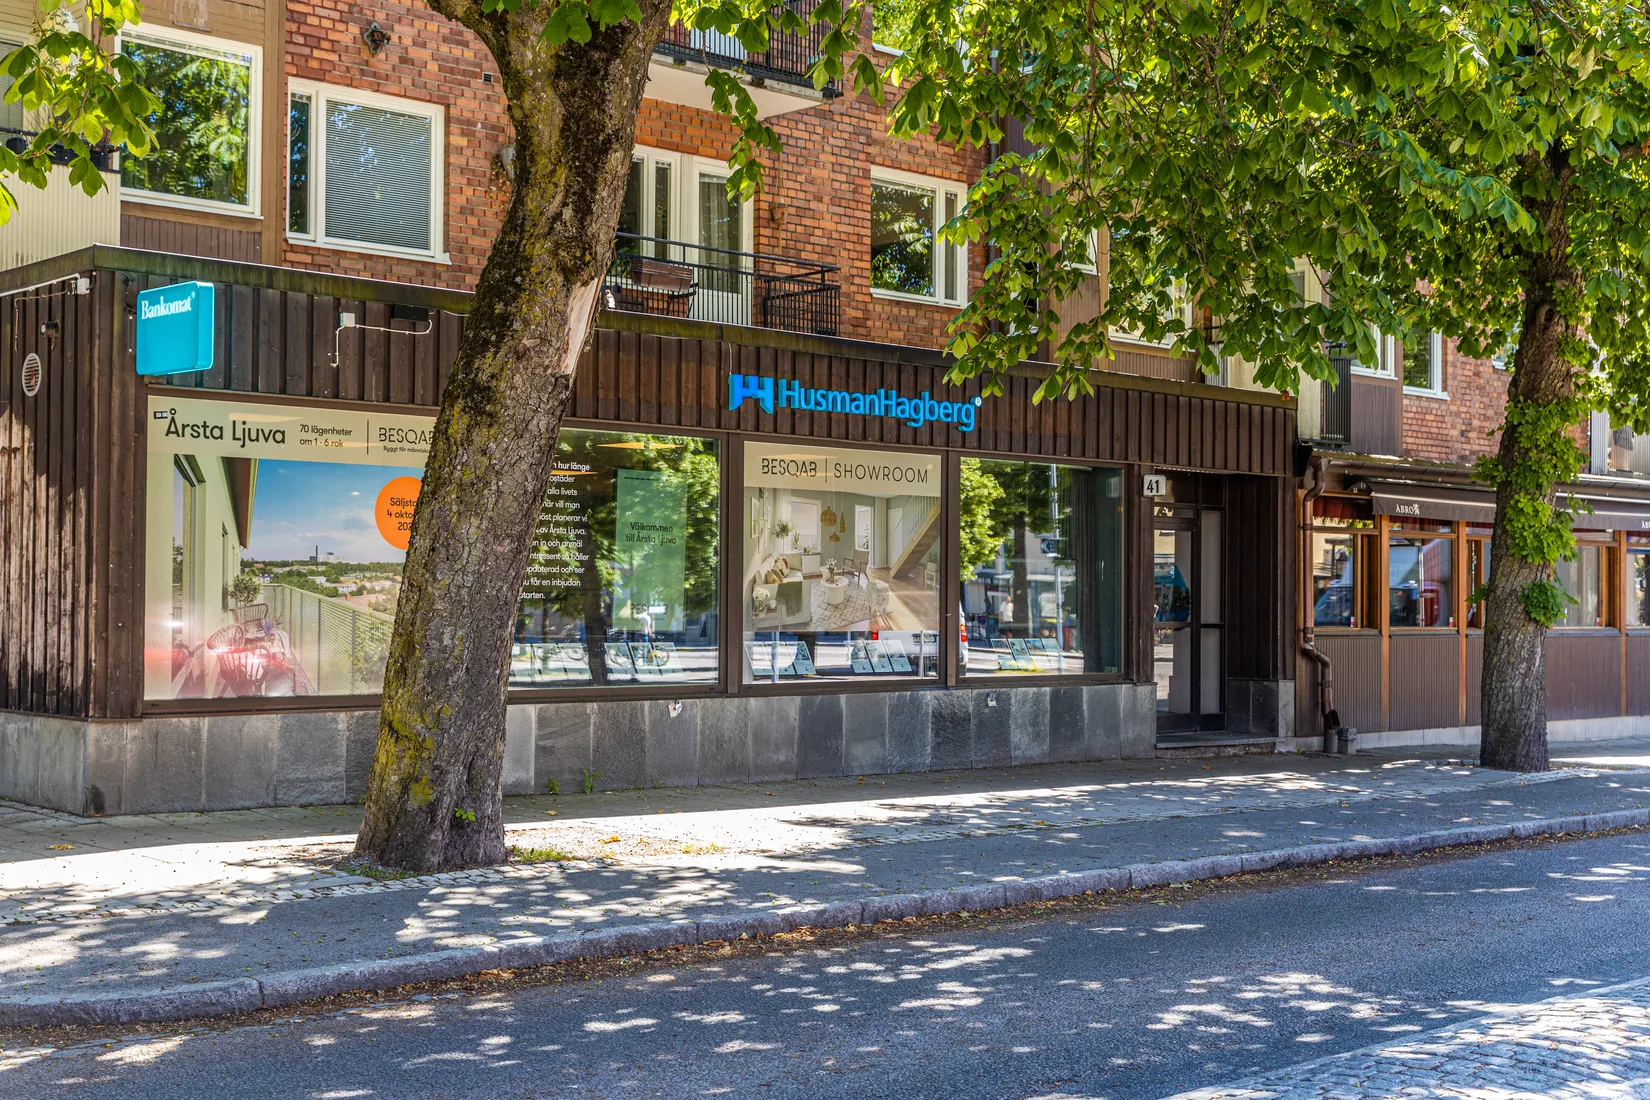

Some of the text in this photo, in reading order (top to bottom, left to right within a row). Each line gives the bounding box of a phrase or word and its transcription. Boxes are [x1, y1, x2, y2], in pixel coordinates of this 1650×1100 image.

[141, 295, 192, 320] Bankomat
[165, 408, 286, 448] Årsta Ljuva
[300, 424, 352, 437] 70 lägenheter
[300, 438, 312, 446] om
[331, 438, 344, 448] rok
[558, 461, 570, 469] hur
[570, 462, 590, 471] länge
[762, 458, 928, 483] BESQAB SHOWROOM
[1146, 479, 1159, 493] 41
[390, 497, 417, 509] Säljsta
[387, 509, 414, 518] 4 okto
[553, 513, 580, 522] planerar
[398, 521, 412, 531] 202
[549, 523, 566, 533] Årsta
[630, 522, 673, 532] Välkommen
[626, 531, 676, 546] till Årsta Ljuva
[571, 552, 589, 560] håller
[531, 577, 540, 585] får
[552, 578, 580, 587] inbjudan
